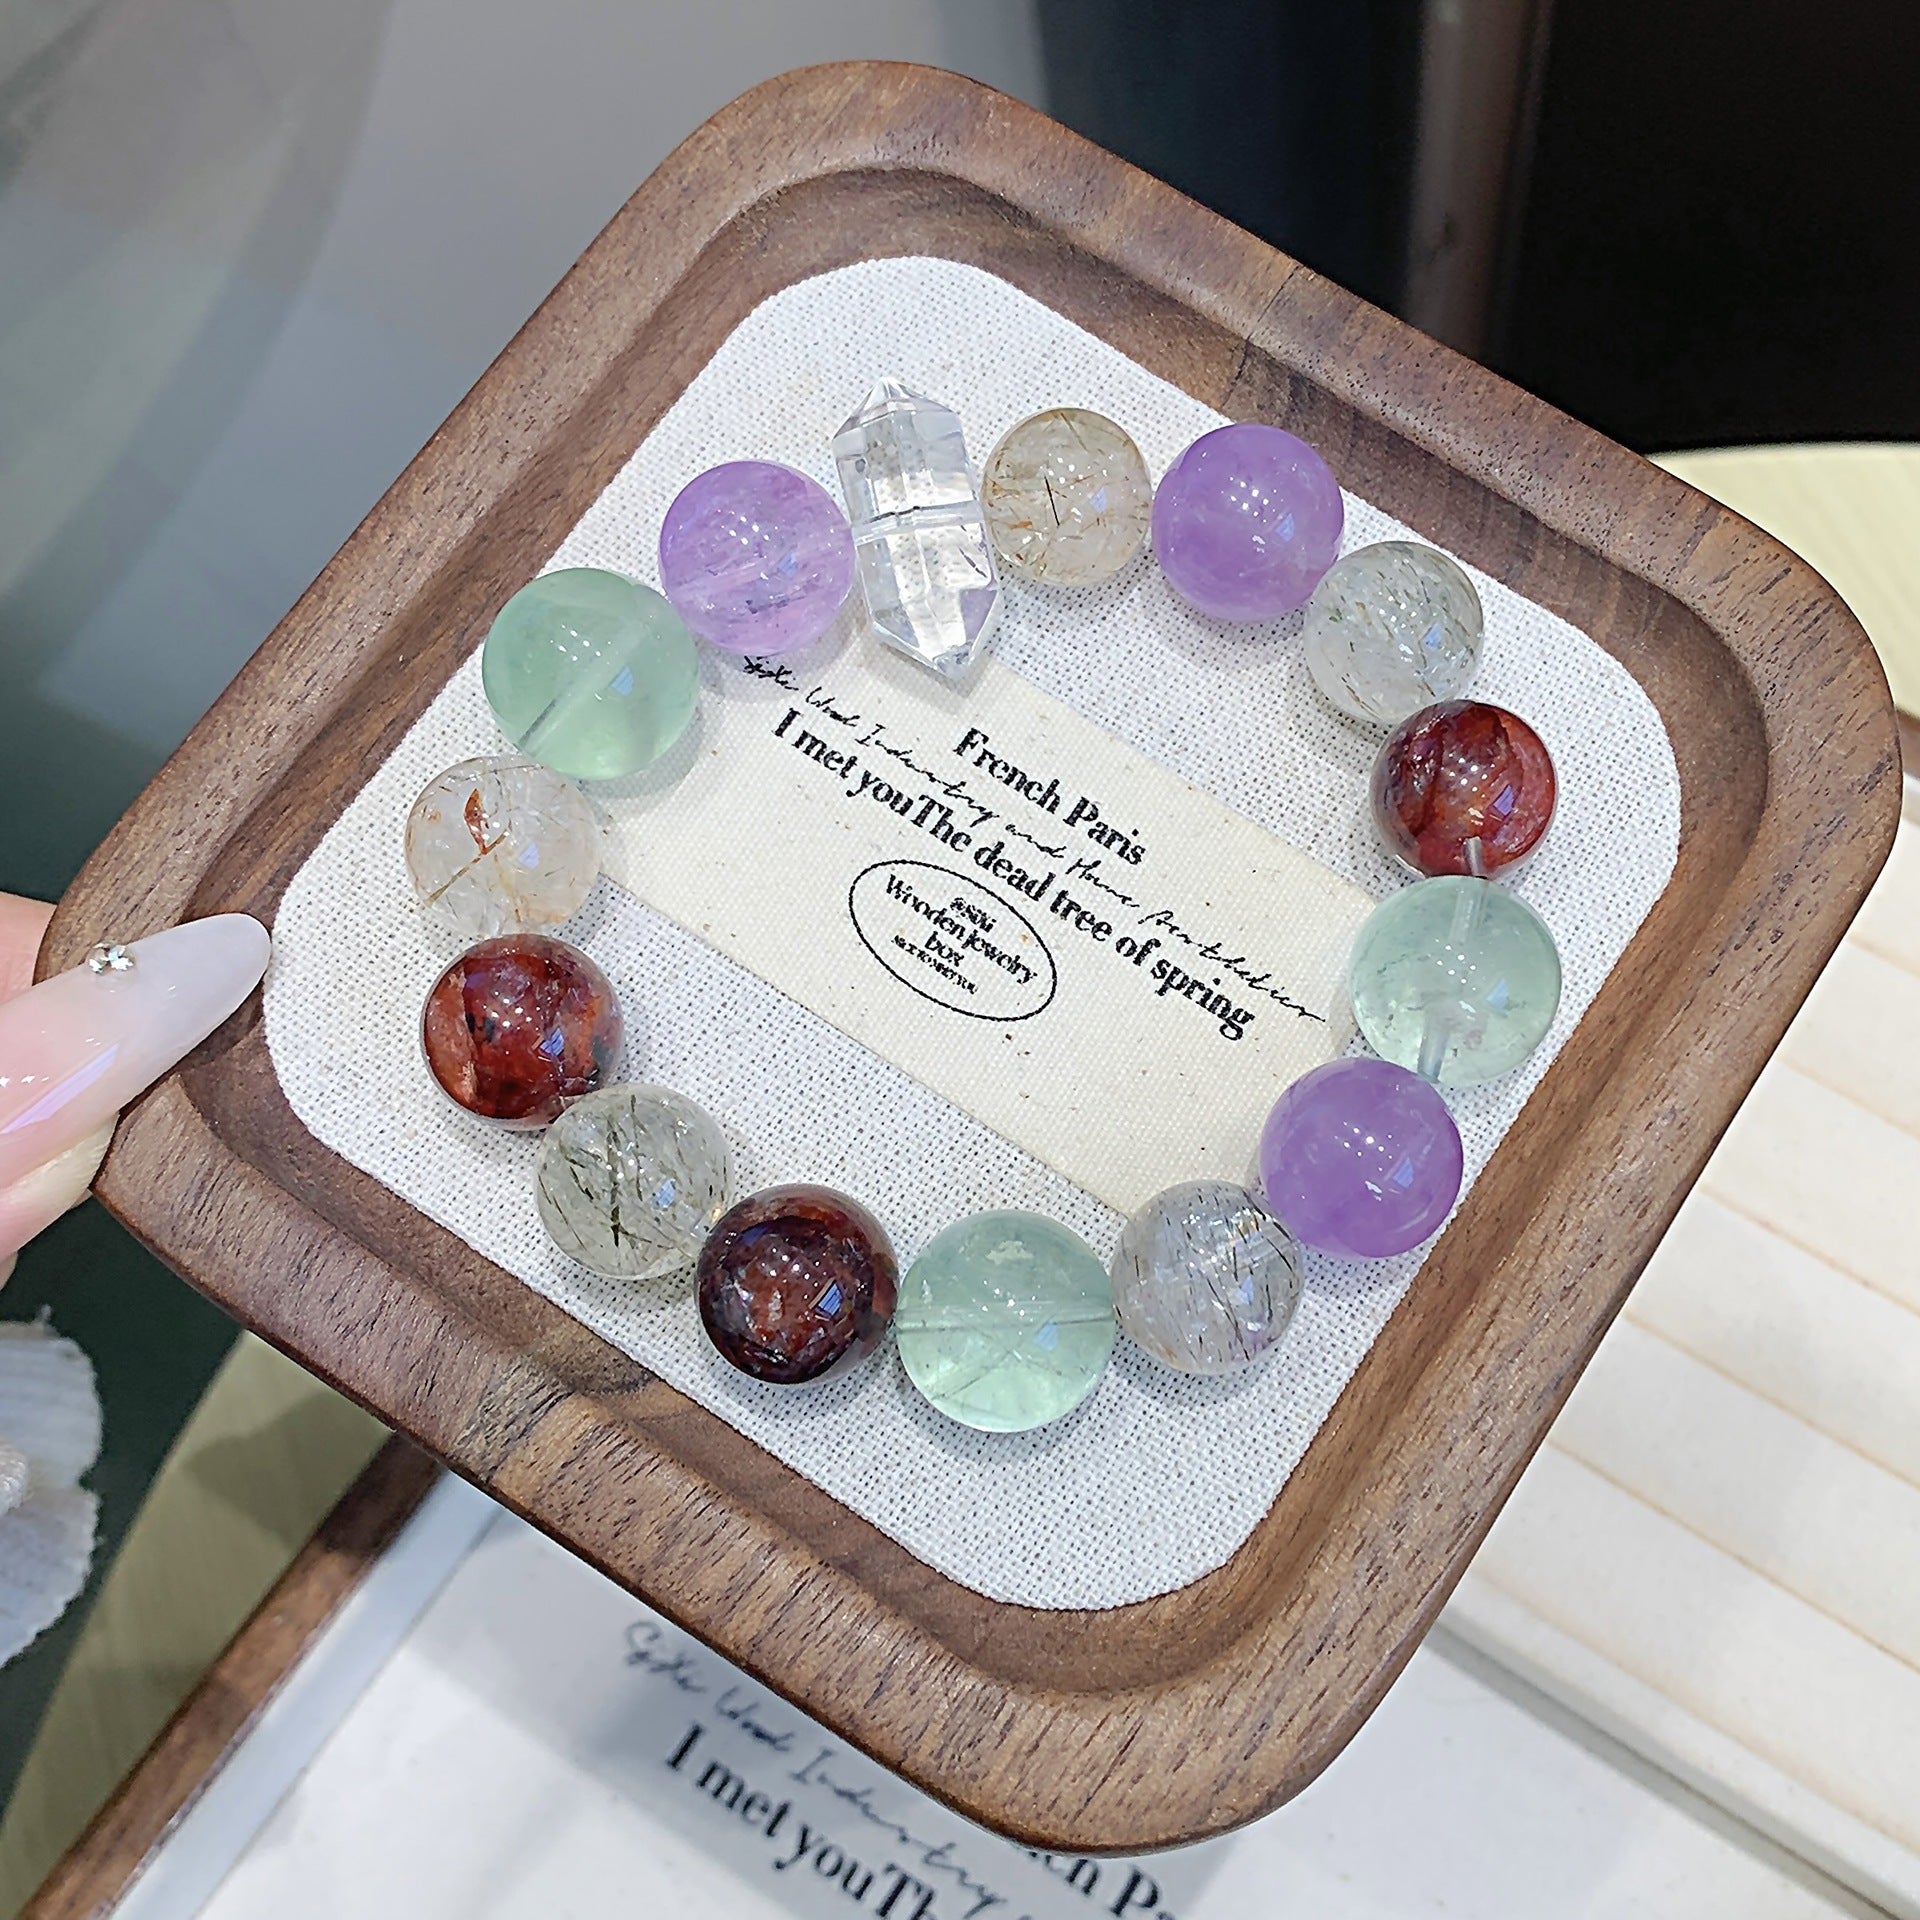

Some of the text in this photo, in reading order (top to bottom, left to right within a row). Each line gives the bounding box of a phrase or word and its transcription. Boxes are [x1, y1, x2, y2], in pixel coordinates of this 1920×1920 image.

[953, 728, 1146, 865] French Paris
[772, 707, 801, 739] I
[792, 729, 858, 779] met
[973, 841, 1056, 901] dead
[1050, 889, 1113, 942] tree
[1116, 938, 1161, 966] of
[1150, 958, 1255, 1041] spring
[924, 931, 964, 967] box
[961, 929, 1038, 984] jewelry
[666, 1722, 705, 1771] I
[696, 1760, 792, 1838] met
